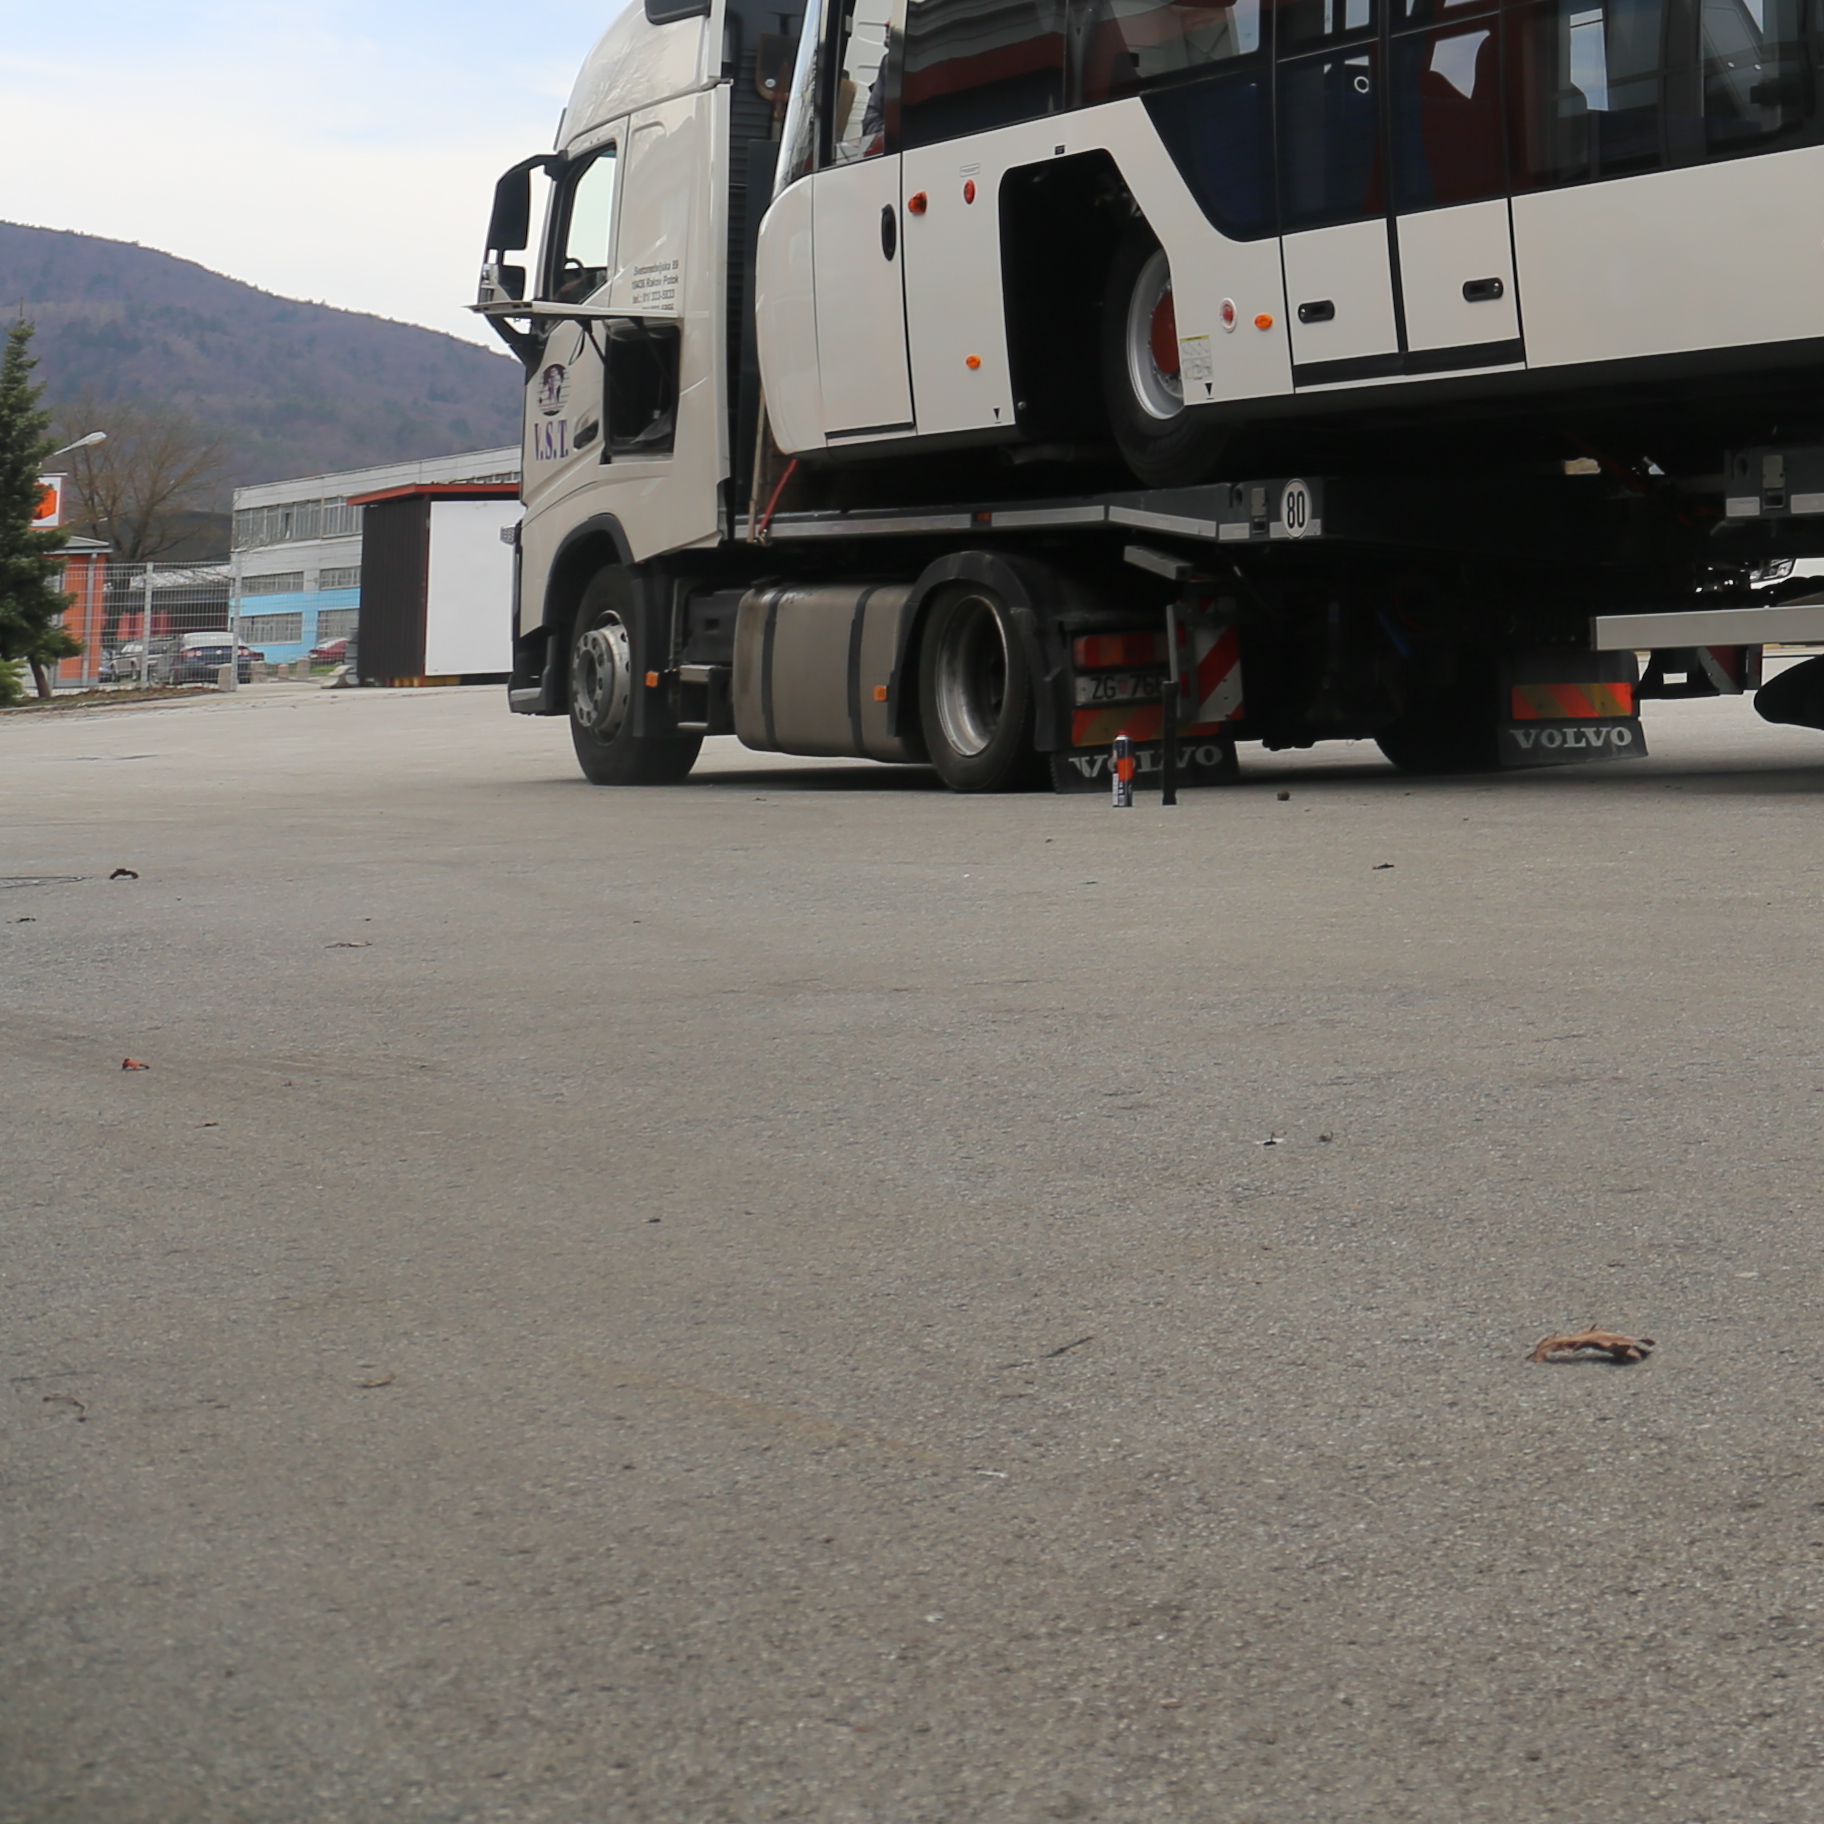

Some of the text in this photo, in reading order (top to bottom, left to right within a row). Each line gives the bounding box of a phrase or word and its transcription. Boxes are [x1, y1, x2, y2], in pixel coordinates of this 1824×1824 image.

[1287, 490, 1305, 529] 80
[1091, 676, 1116, 700] ZG
[1509, 727, 1632, 750] VOLVO
